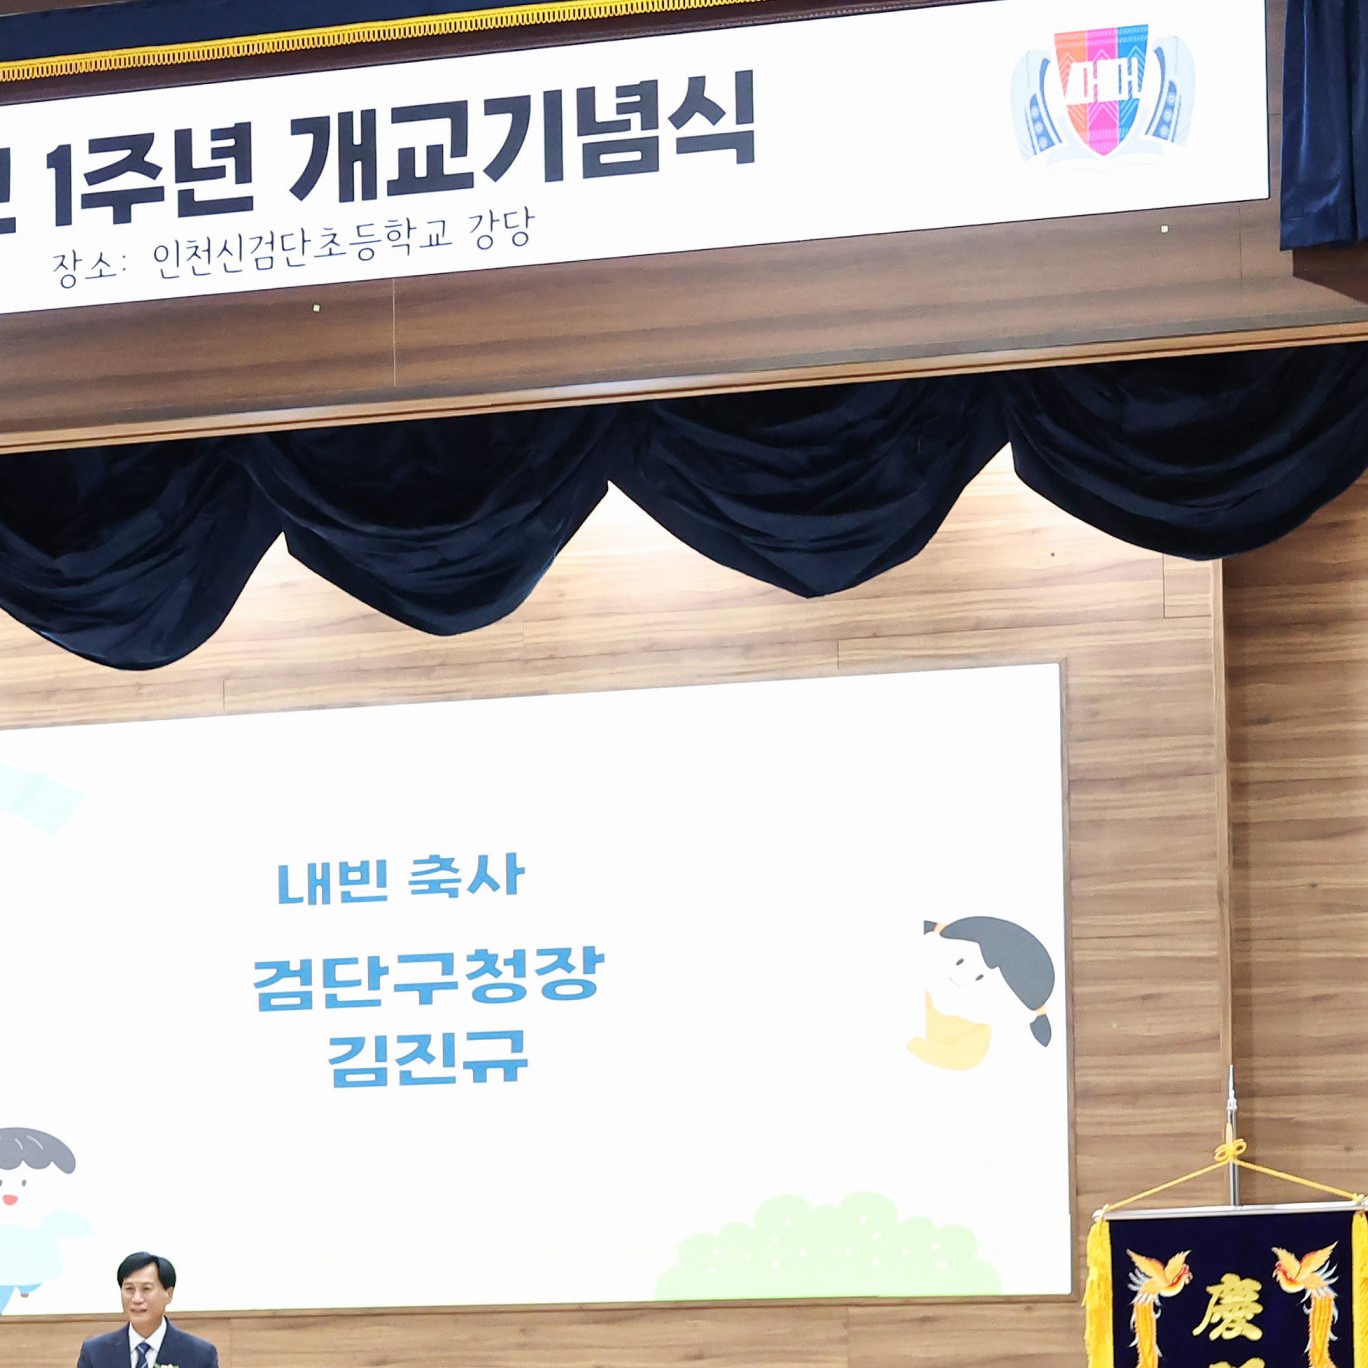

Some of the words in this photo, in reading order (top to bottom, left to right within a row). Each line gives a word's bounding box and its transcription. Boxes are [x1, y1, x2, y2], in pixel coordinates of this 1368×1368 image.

[46, 121, 255, 227] 1주년
[288, 69, 756, 203] 개교기념식
[52, 249, 127, 289] 장소:
[152, 217, 453, 280] 인천신검단초등학교
[468, 206, 536, 251] 강당
[277, 859, 389, 906] 내빈
[407, 852, 526, 899] 축사
[253, 946, 605, 1012] 검단구청장
[327, 1030, 529, 1089] 김진규
